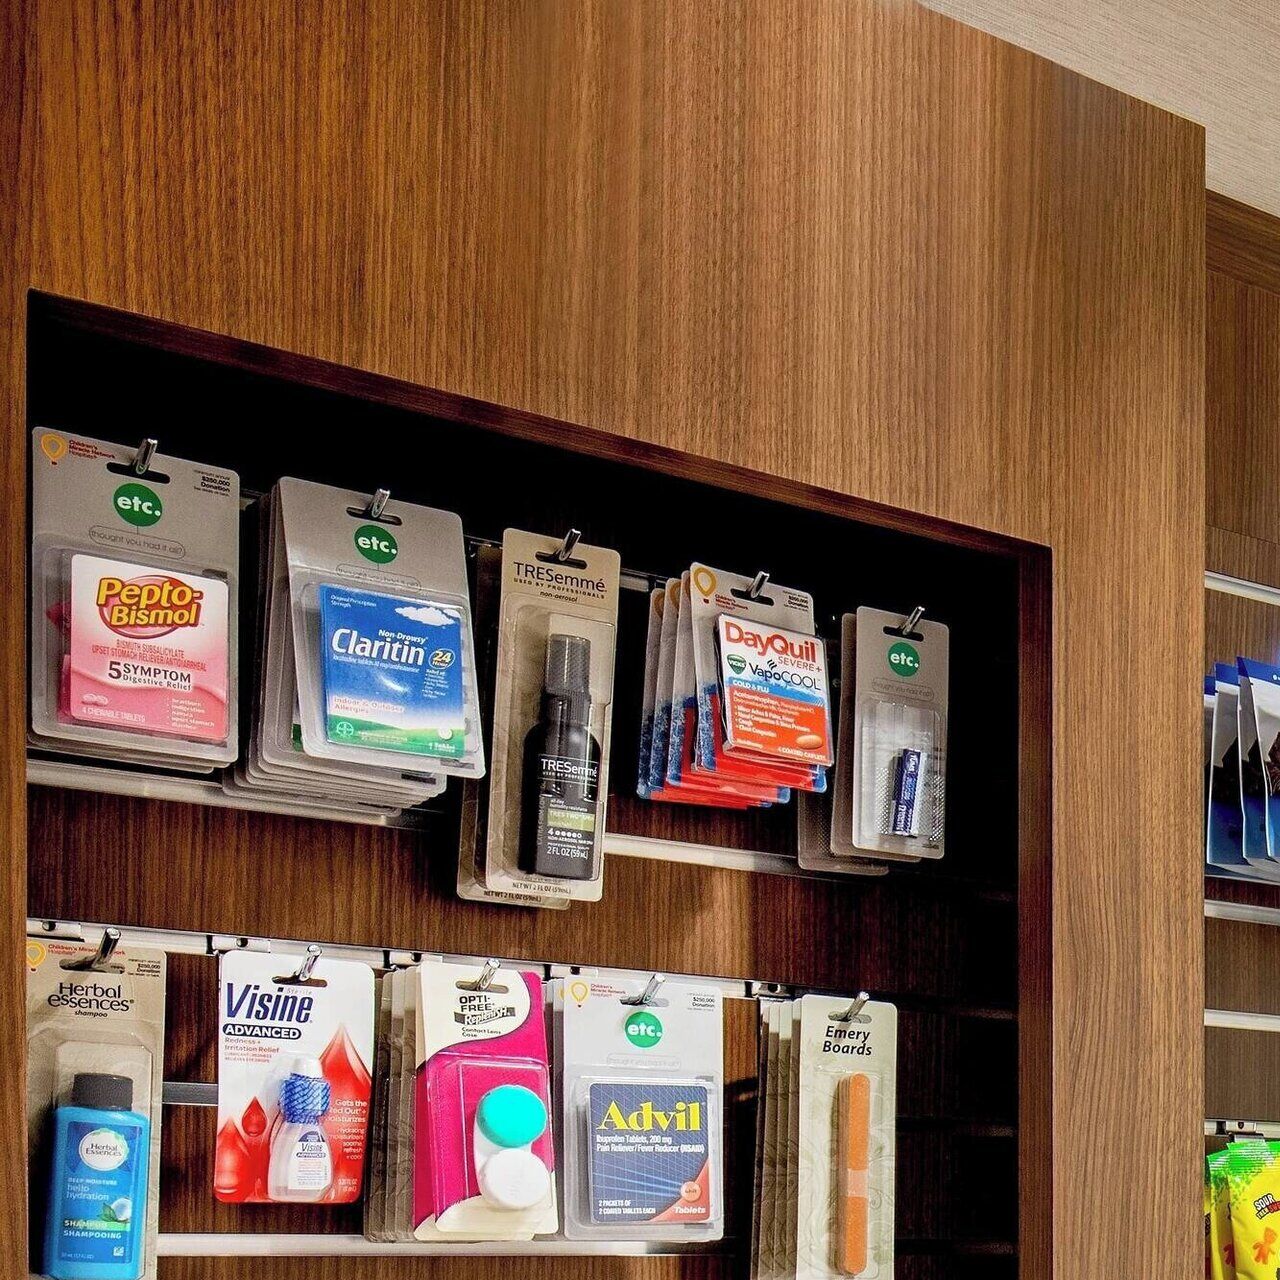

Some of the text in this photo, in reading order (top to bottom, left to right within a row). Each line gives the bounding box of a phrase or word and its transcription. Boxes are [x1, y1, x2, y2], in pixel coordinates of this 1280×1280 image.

[117, 496, 161, 517] etc.
[358, 536, 397, 555] etc.
[514, 561, 607, 592] TRESemmé
[97, 577, 203, 608] Pepto-
[110, 602, 201, 627] Bismol
[332, 628, 425, 666] Claritin
[725, 622, 818, 663] DayQuil
[433, 650, 451, 662] 24
[108, 661, 191, 683] 5 SYMPTOM
[122, 674, 163, 687] Digestive
[59, 982, 121, 998] Herbal
[48, 994, 130, 1011] essences
[226, 982, 314, 1023] Visine
[459, 995, 491, 1005] OPTI-
[461, 1004, 492, 1013] FREE
[225, 1026, 300, 1038] ADVANCED
[627, 1021, 662, 1037] etc.
[825, 1025, 870, 1043] Emery
[823, 1041, 872, 1056] Boards
[596, 1100, 701, 1132] Advil
